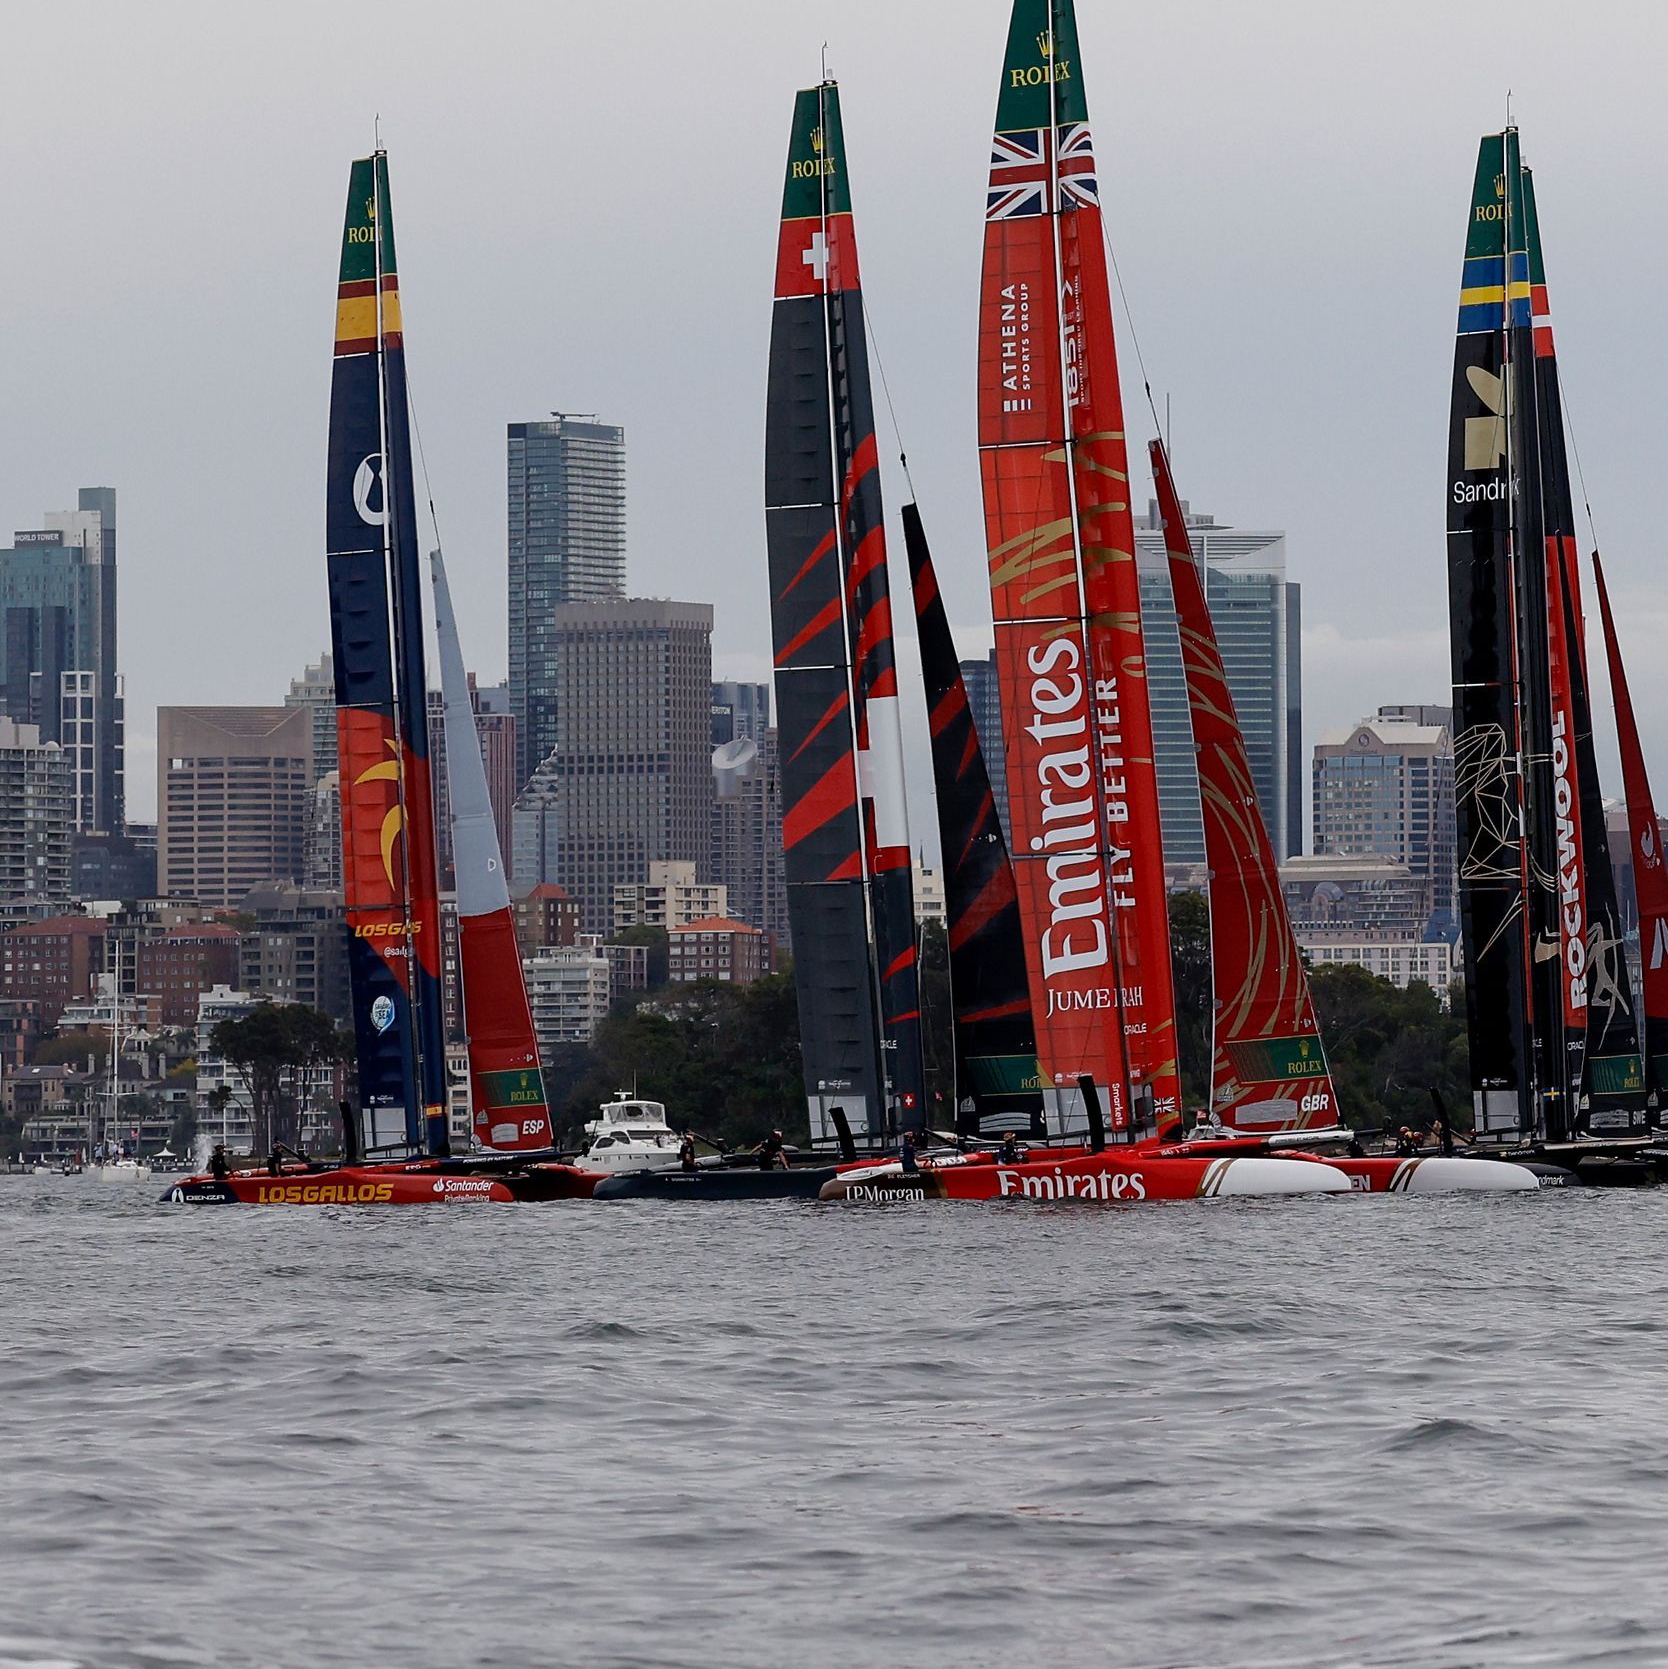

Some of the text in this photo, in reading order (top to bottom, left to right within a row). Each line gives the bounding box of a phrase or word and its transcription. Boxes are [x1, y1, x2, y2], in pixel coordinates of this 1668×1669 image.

[1001, 284, 1018, 392] ATHENA
[1020, 283, 1032, 391] SPORTS GROUP
[1096, 676, 1137, 908] FLY BETTER
[1023, 637, 1109, 980] Emirates
[1553, 710, 1588, 1010] ROCKWOOL
[1124, 1023, 1147, 1035] ORACLE
[1288, 1060, 1322, 1074] ROLEX
[510, 1090, 539, 1102] ROLEX
[1112, 1083, 1124, 1126] Smarkets
[1301, 1094, 1329, 1112] GBR
[522, 1119, 545, 1135] ESP
[1632, 1110, 1646, 1125] SWE
[259, 1183, 395, 1204] LOSGALLOS
[445, 1180, 494, 1192] Santander
[996, 1167, 1146, 1201] Emirates
